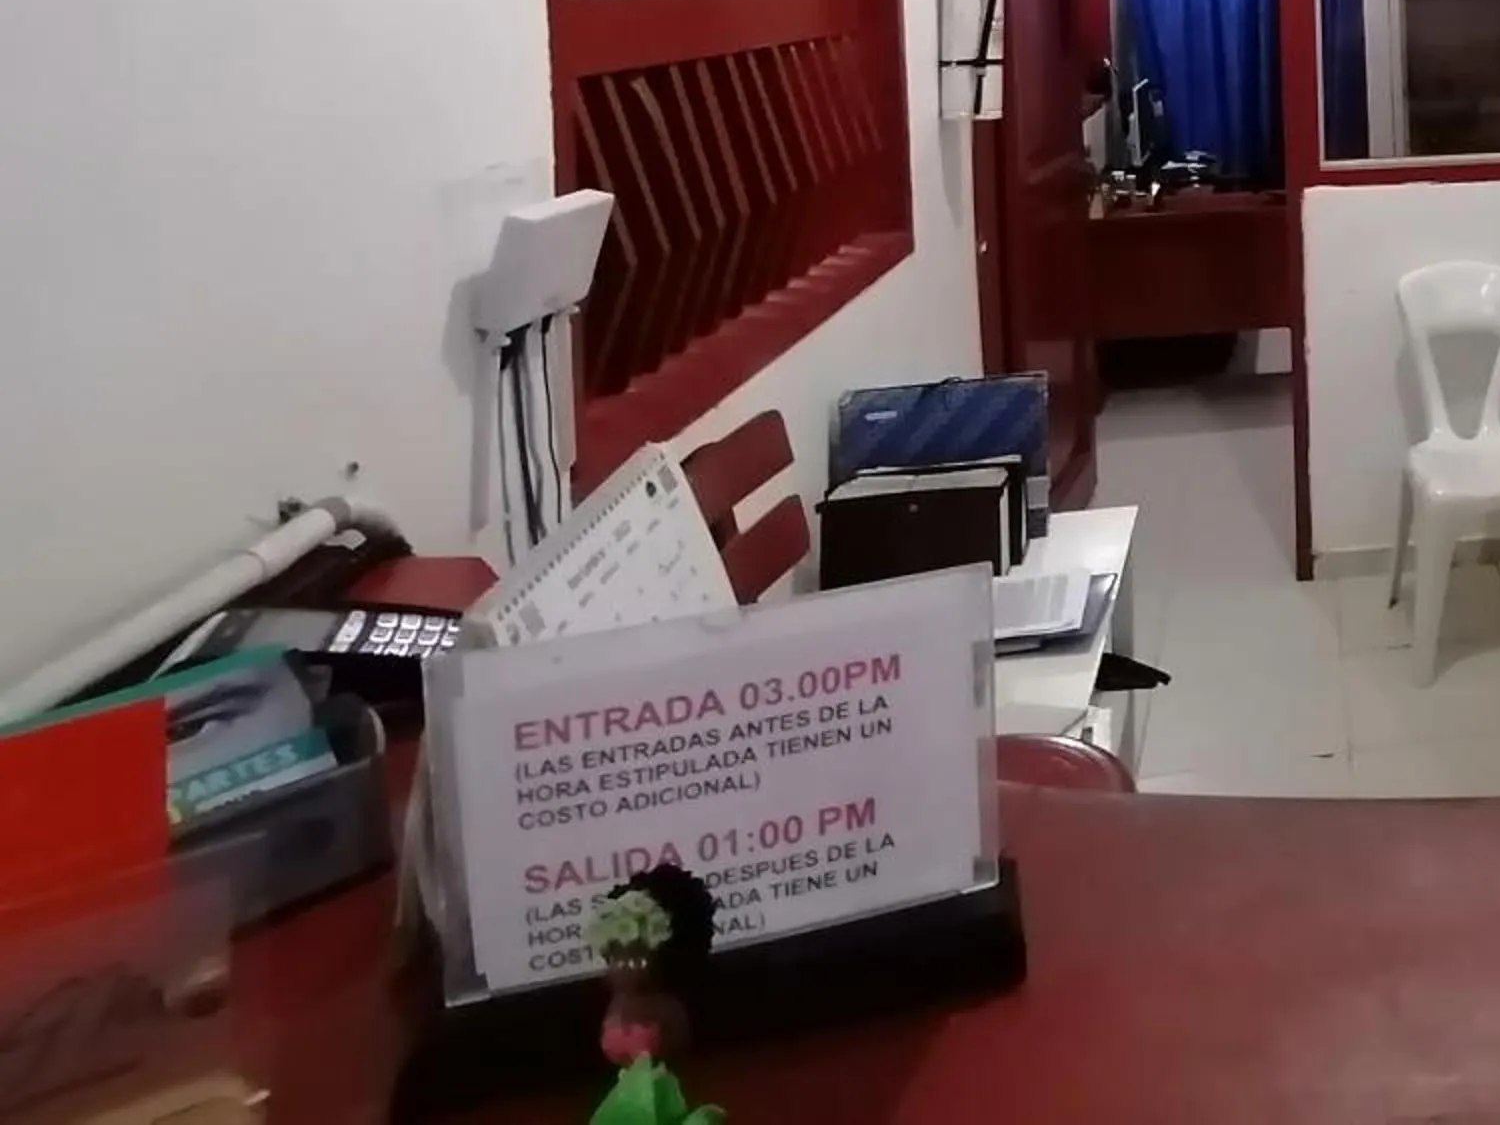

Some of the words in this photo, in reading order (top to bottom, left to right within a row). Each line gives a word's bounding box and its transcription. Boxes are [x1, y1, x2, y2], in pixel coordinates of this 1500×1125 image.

[513, 690, 726, 752] ENTRADA
[739, 653, 902, 710] 03.00PM
[516, 755, 574, 782] (LAS
[582, 726, 721, 770] ENTRADAS
[729, 710, 811, 742] ANTES
[819, 701, 849, 722] DE
[858, 695, 890, 716] LA
[517, 779, 591, 805] HORA
[599, 746, 757, 792] ESTIPULADA
[766, 729, 852, 760] TIENEN
[860, 717, 893, 740] UN
[518, 801, 608, 831] COSTO
[616, 771, 762, 814] ADICIONAL)
[524, 841, 684, 895] SALIDA
[698, 815, 803, 862] 01:00
[817, 796, 877, 836] PM
[525, 898, 582, 926] (LAS
[705, 850, 819, 890] DESPUES
[828, 843, 858, 863] DE
[865, 832, 896, 852] LA
[527, 922, 582, 947] HOR
[769, 873, 838, 900] TIENE
[846, 860, 879, 883] UN
[528, 947, 596, 973] COST
